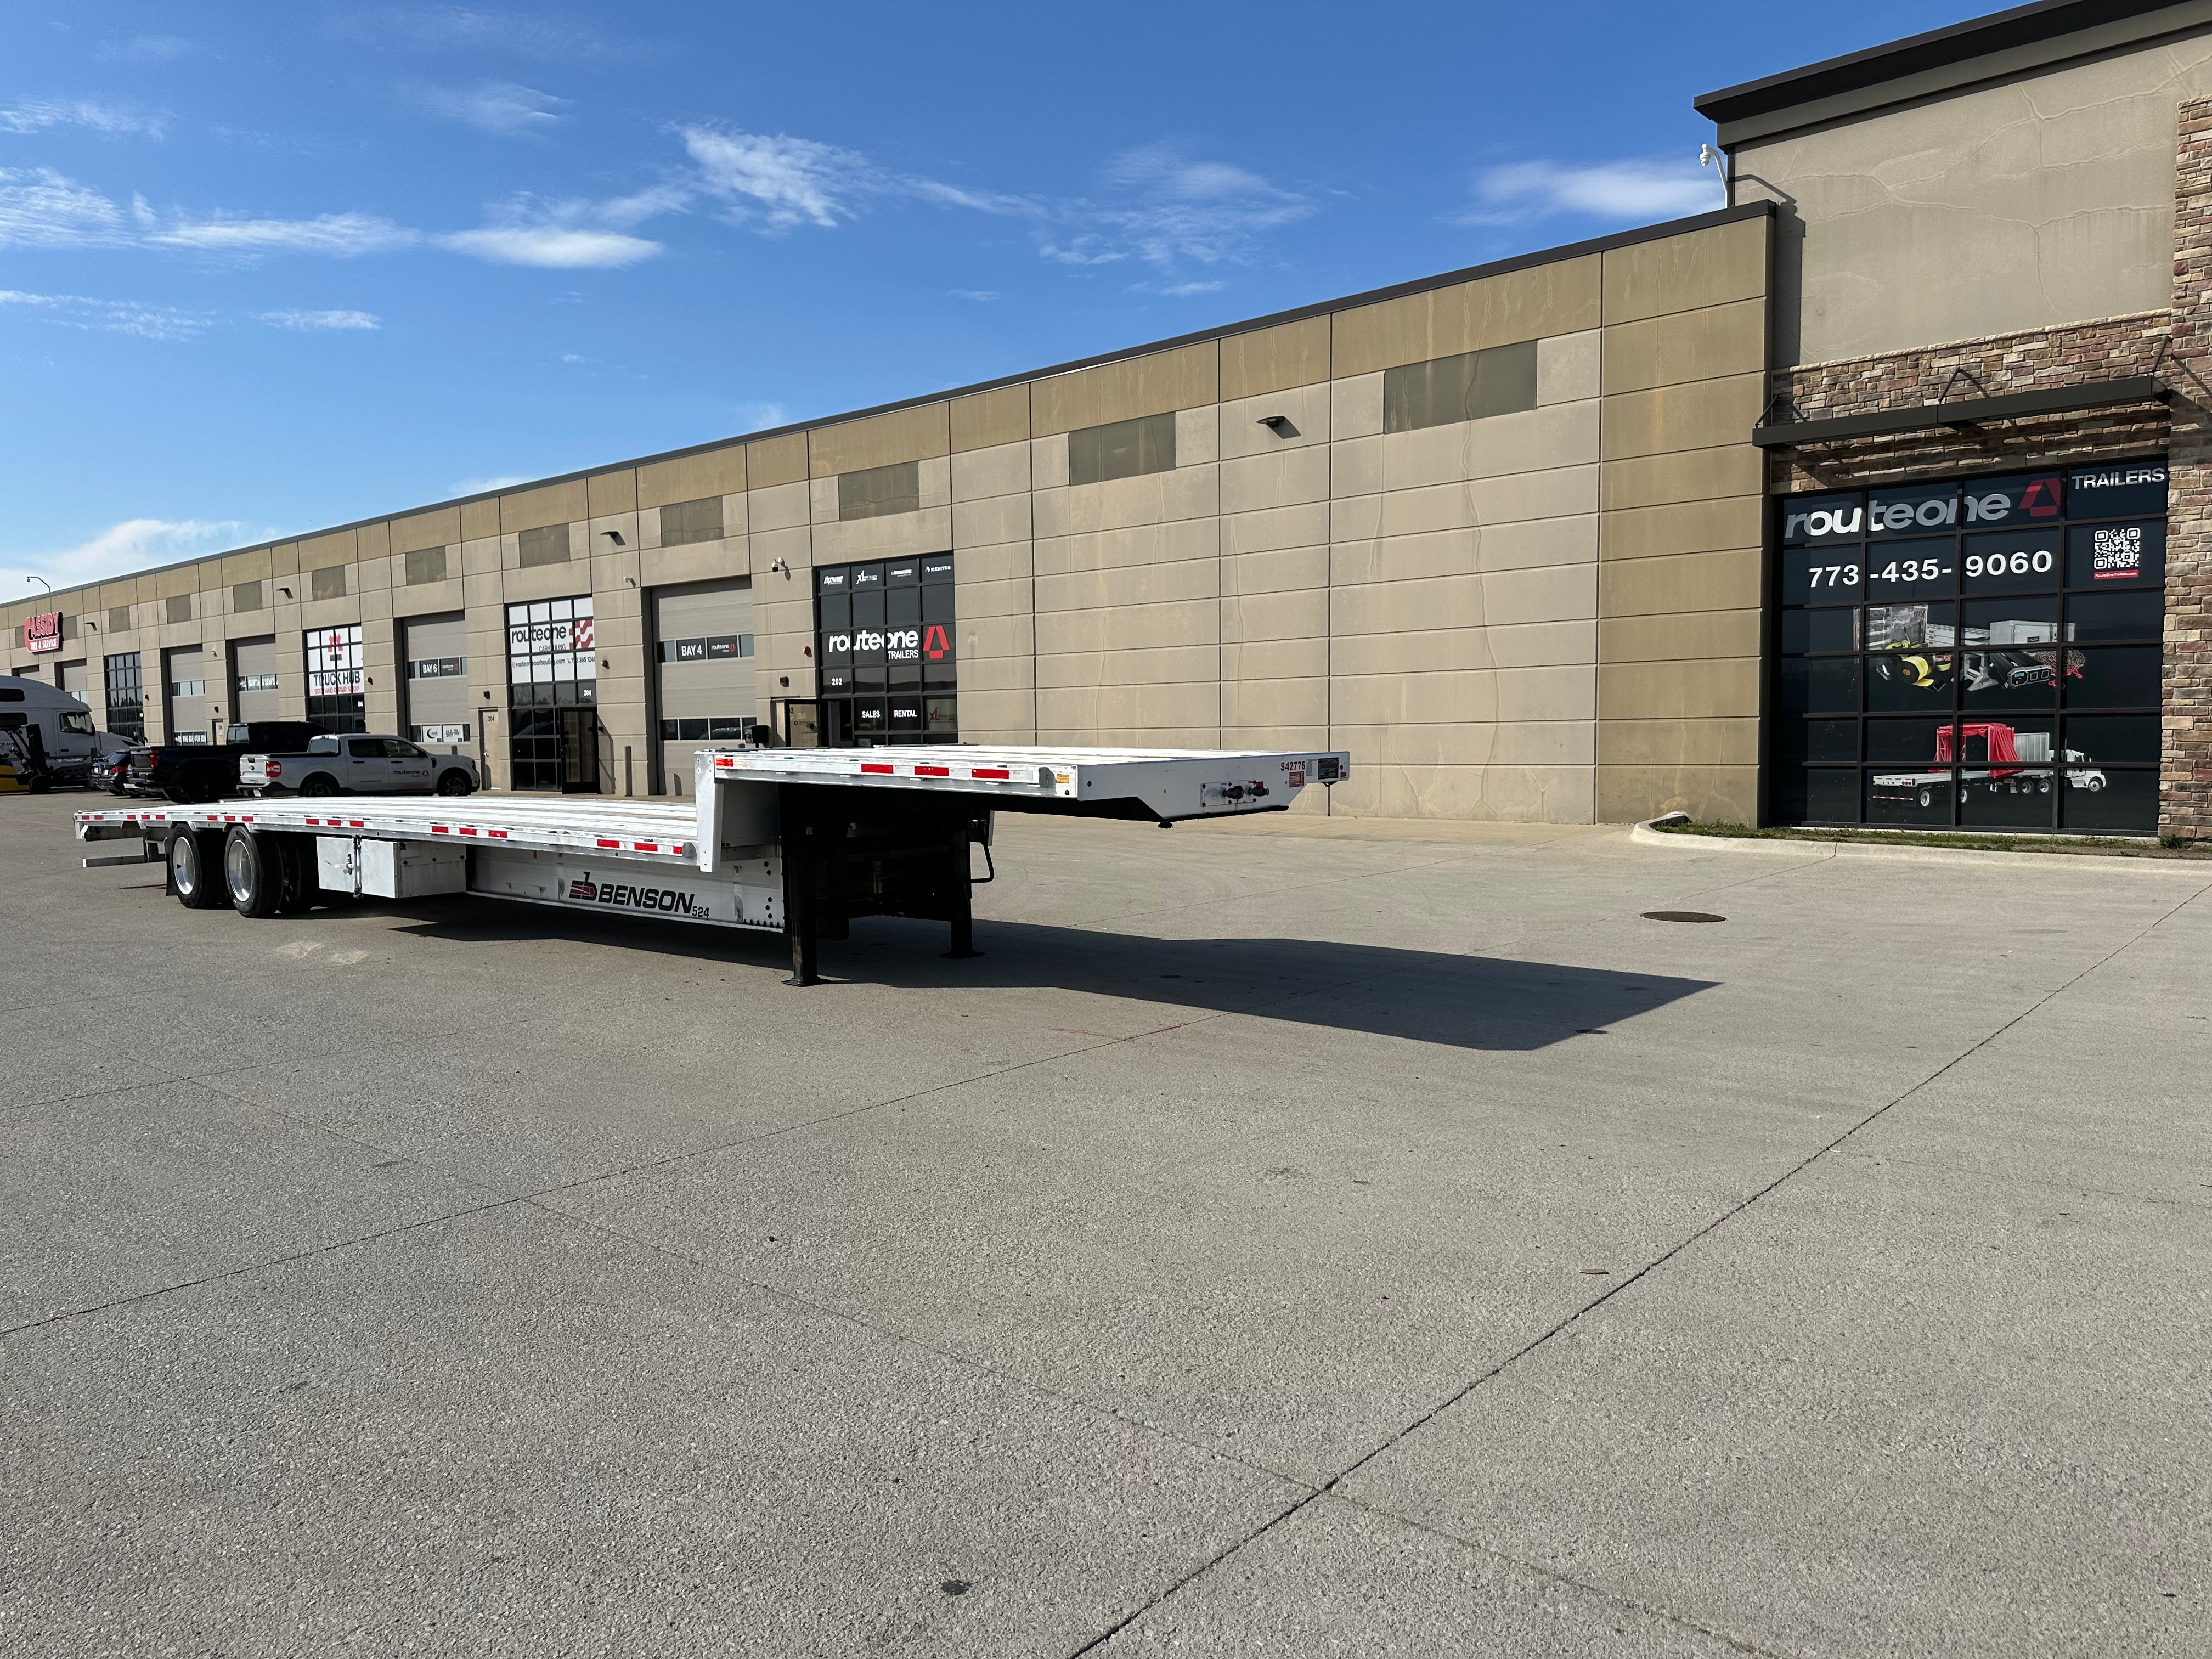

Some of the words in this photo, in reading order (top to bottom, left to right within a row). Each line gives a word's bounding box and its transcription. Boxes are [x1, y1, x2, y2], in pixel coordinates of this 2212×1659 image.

[2072, 467, 2165, 490] TRAILERS
[1785, 493, 2011, 539] routeone
[1809, 565, 1859, 588] 773
[1966, 550, 2052, 577] 9060
[824, 575, 843, 585] EXTREME
[856, 570, 866, 584] XL
[25, 612, 59, 639] CASSIDY
[512, 625, 566, 644] routeone
[829, 630, 918, 652] routeone
[681, 645, 696, 656] BAY
[697, 645, 702, 655] 4
[888, 650, 919, 659] TRAILERS
[422, 664, 432, 674] BAY
[433, 664, 437, 673] 6
[343, 671, 360, 685] HUB
[832, 678, 842, 686] 202
[862, 710, 880, 718] SALES
[894, 709, 917, 718] RENTAL
[1280, 761, 1306, 771] S42776
[598, 883, 695, 914] BENSON
[692, 906, 709, 918] 524
